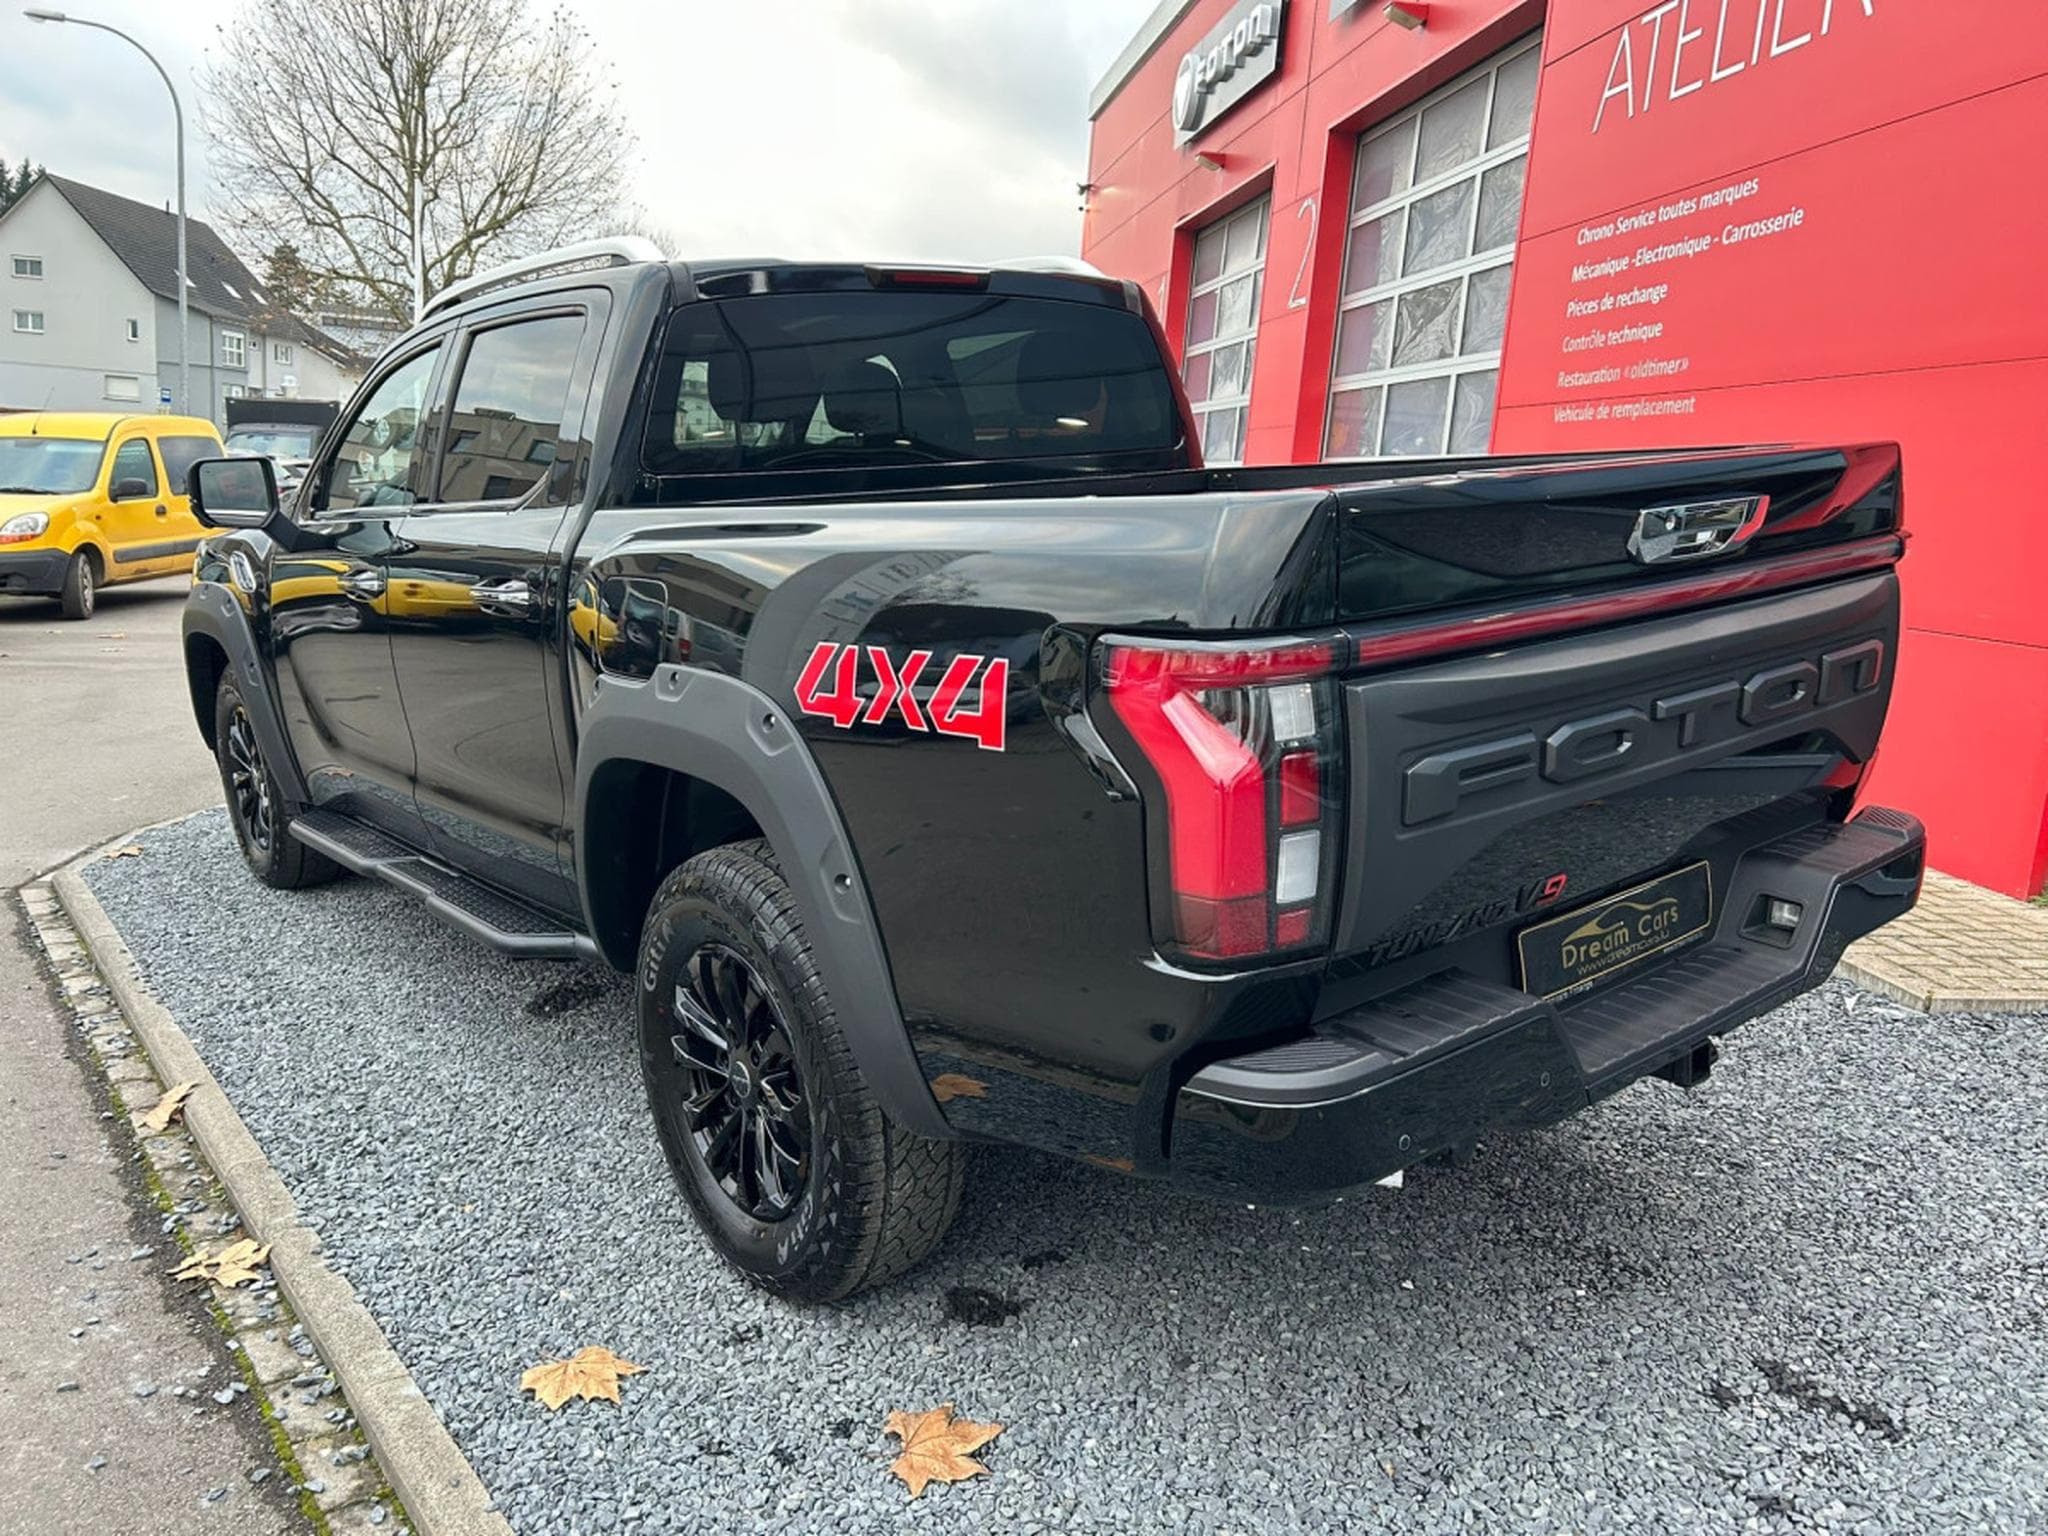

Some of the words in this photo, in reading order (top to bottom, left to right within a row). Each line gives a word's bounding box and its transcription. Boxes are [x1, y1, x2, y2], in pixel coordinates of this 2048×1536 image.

[1577, 223, 1614, 245] Chrono
[1616, 210, 1656, 235] Service
[1658, 197, 1697, 222] toutes
[1699, 177, 1760, 206] marques
[1287, 198, 1317, 309] 2
[1571, 254, 1629, 283] Mécanique
[1722, 207, 1805, 245] Carrosserie
[1566, 299, 1599, 318] Pièces
[1600, 292, 1615, 311] de
[1616, 283, 1669, 304] rechange
[1562, 330, 1606, 353] Contrôle
[1607, 322, 1664, 343] technique
[1557, 365, 1621, 388] Restauration
[1596, 402, 1610, 420] de
[1611, 396, 1697, 421] remplacement
[1403, 638, 1885, 827] FOTON
[1514, 872, 1568, 911] V9
[1561, 926, 1630, 969] Dream
[1638, 905, 1680, 937] Cars
